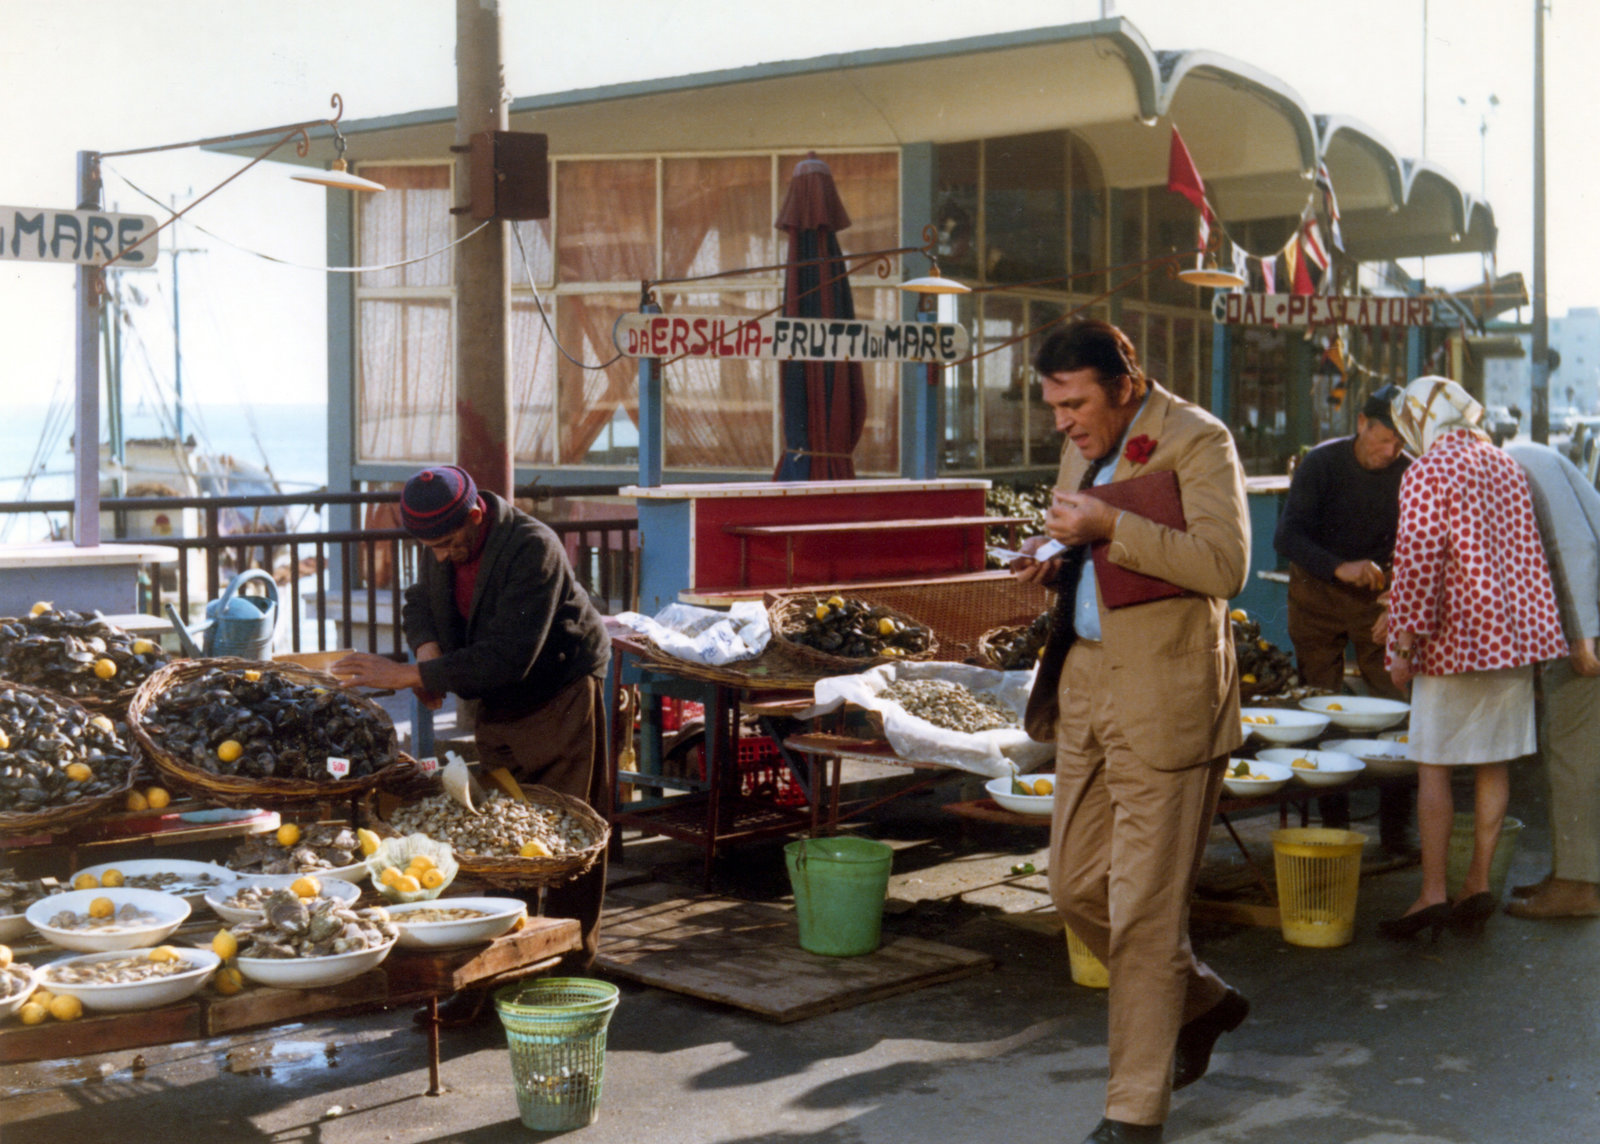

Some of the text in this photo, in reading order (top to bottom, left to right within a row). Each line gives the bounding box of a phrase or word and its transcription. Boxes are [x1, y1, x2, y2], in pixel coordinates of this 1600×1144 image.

[11, 211, 144, 262] MARE
[1226, 294, 1433, 326] DAL PESCATORE
[628, 328, 649, 354] DA
[773, 321, 868, 357] FRUTTI
[884, 325, 957, 359] MARE
